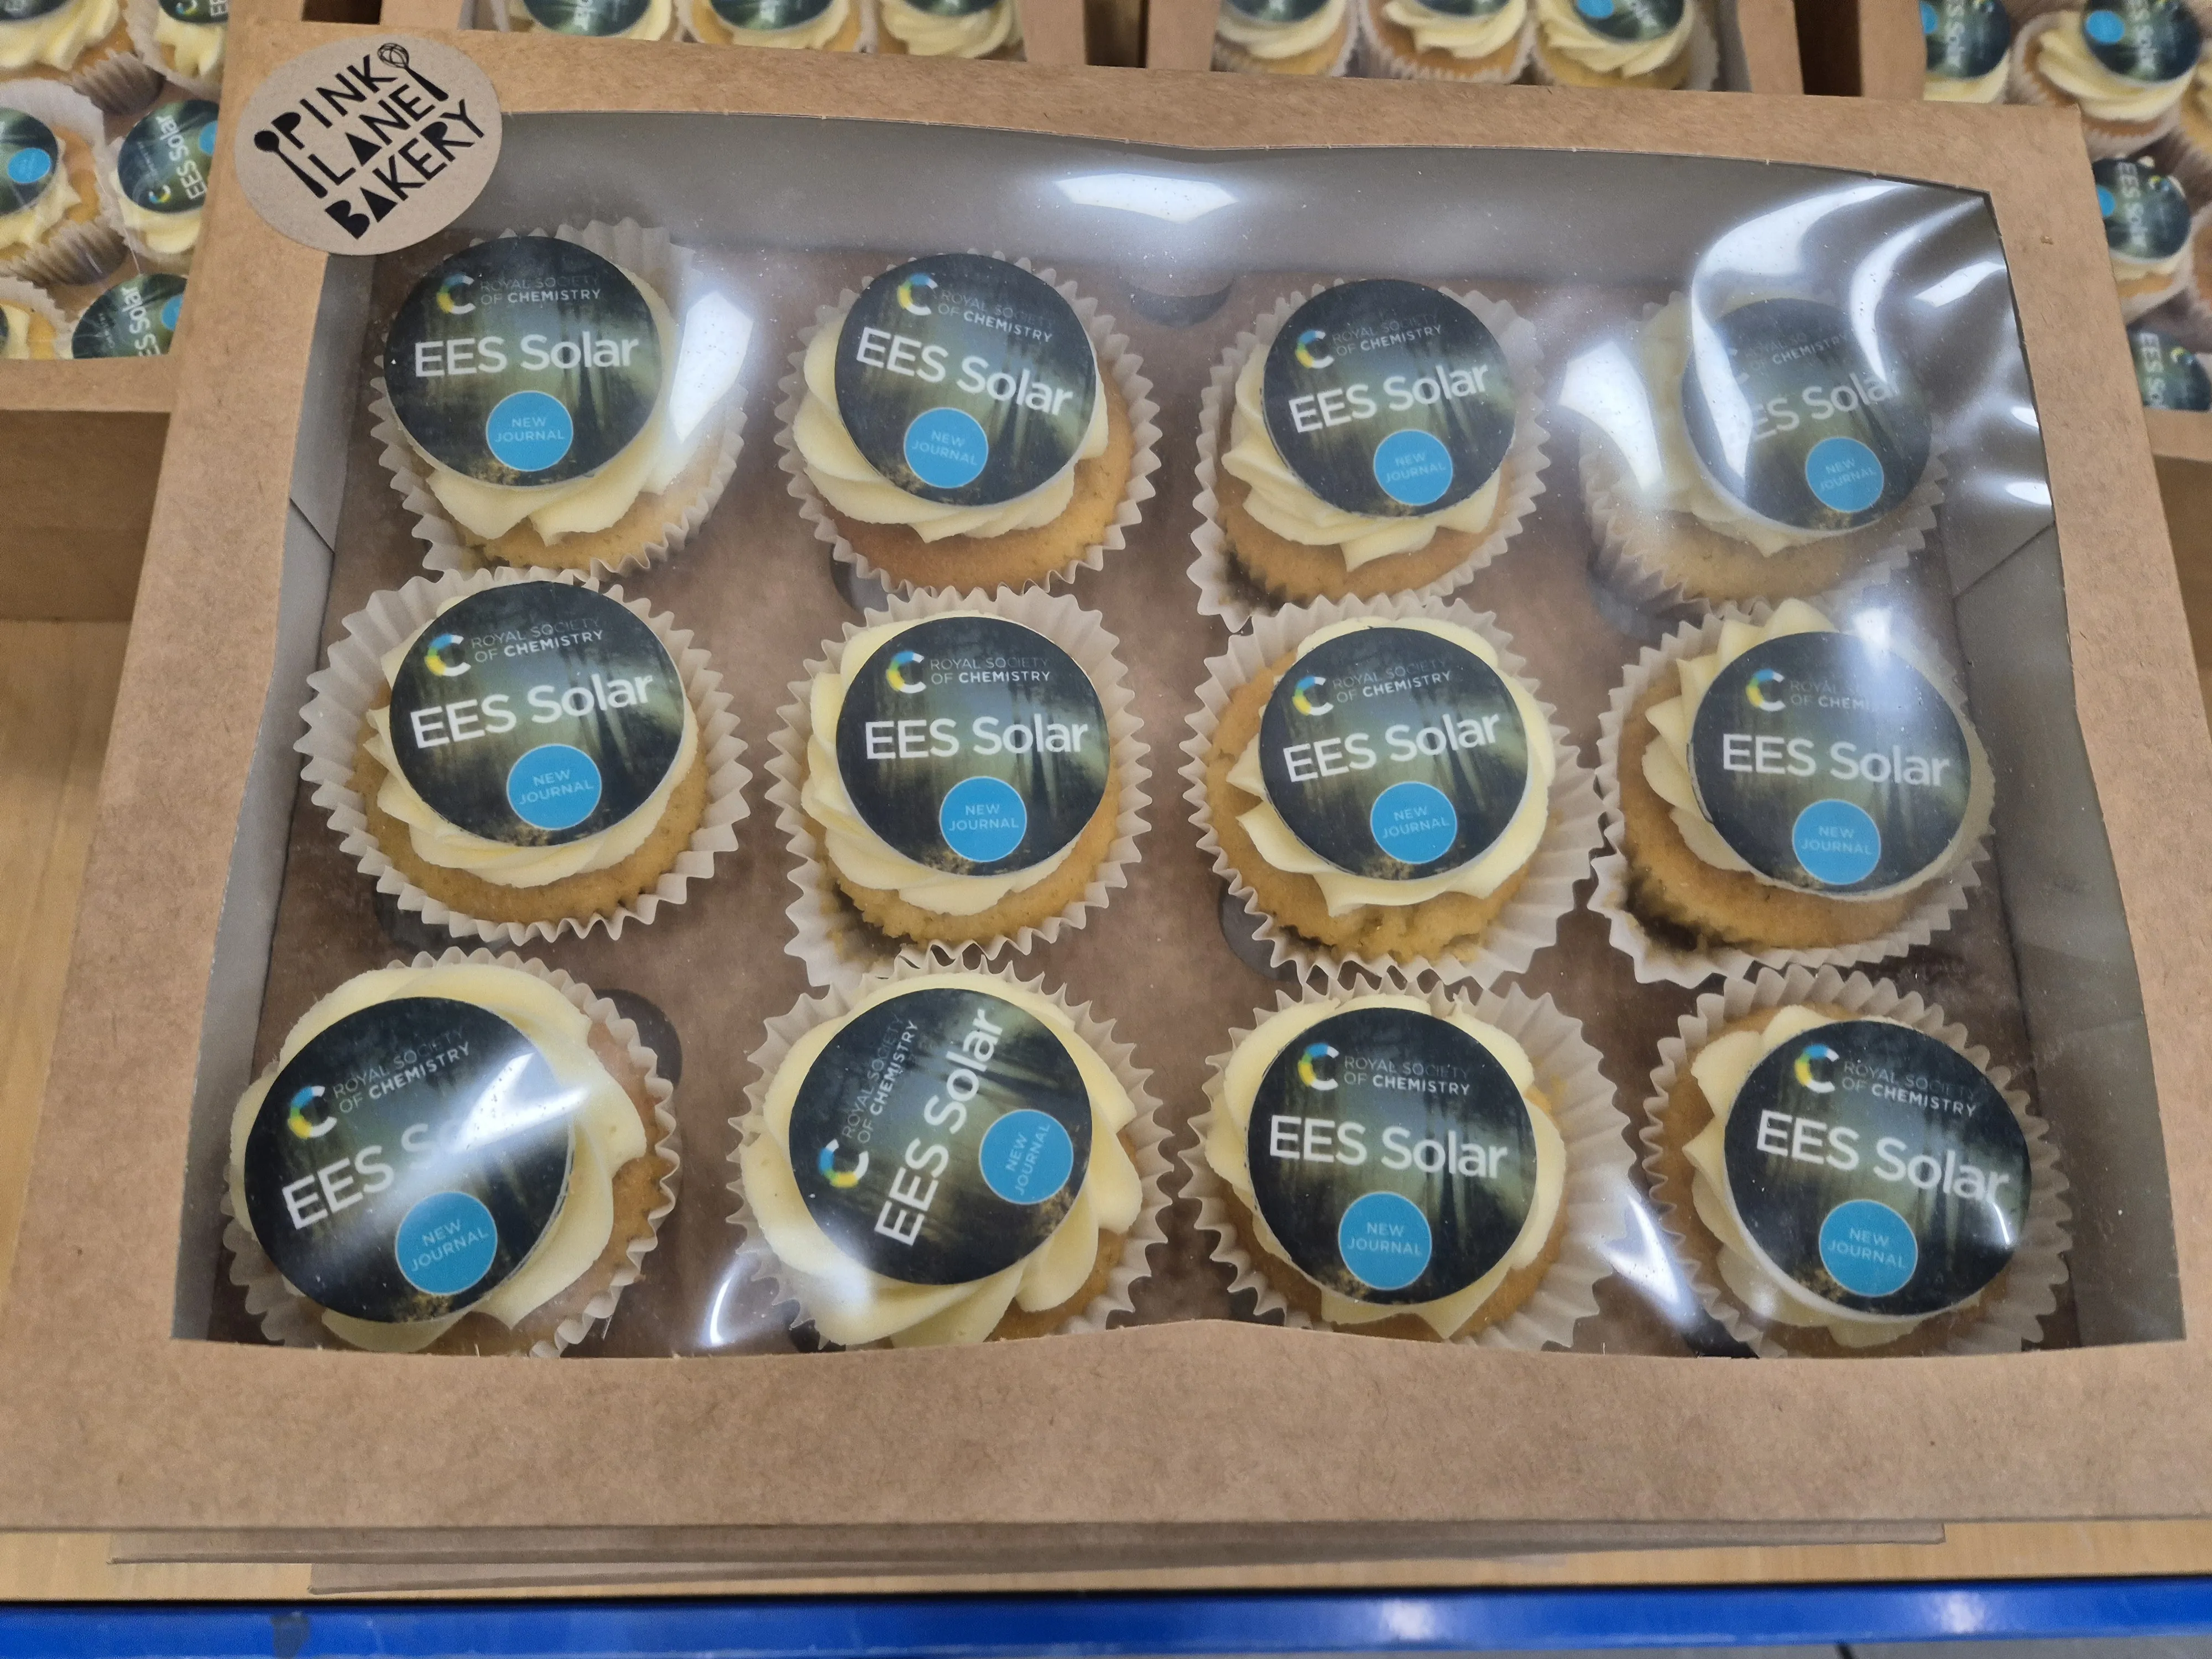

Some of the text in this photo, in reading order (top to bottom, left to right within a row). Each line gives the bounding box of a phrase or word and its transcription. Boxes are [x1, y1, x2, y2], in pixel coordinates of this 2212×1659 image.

[271, 54, 398, 150] PINK
[156, 116, 189, 161] Solar
[308, 84, 436, 186] LANE
[325, 99, 484, 239] BAKERY
[481, 279, 530, 293] ROYAL
[481, 289, 601, 305] OF CHEMISTRY
[941, 289, 988, 312] ROYAL
[938, 304, 1052, 342] OF CHEMISTRY
[1332, 326, 1375, 343] ROYAL
[1336, 325, 1442, 357] OF CHEMISTRY
[415, 331, 639, 378] EES Solar
[857, 327, 1073, 416] EES Solar
[1288, 364, 1488, 433] EES Solar
[512, 417, 547, 428] NEW
[495, 430, 565, 441] JOURNAL
[931, 430, 966, 447] NEW
[911, 442, 977, 466] JOURNAL
[1395, 452, 1427, 467] NEW
[1826, 458, 1856, 474] NEW
[1386, 463, 1446, 483] JOURNAL
[1819, 467, 1876, 491] JOURNAL
[472, 631, 526, 648] ROYAL
[474, 630, 604, 663] OF CHEMISTRY
[931, 657, 1050, 670] ROYAL SOCIETY
[931, 671, 1051, 685] OF CHEMISTRY
[1333, 672, 1380, 689] ROYAL
[1336, 671, 1451, 703] OF CHEMISTRY
[410, 674, 653, 748] EES Solar
[1791, 693, 1809, 706] OF
[865, 713, 1088, 759] EES Solar
[1283, 713, 1500, 782] EES Solar
[1723, 733, 1952, 787] EES Solar
[533, 769, 572, 786] NEW
[518, 780, 594, 806] JOURNAL
[966, 804, 1000, 816] NEW
[1394, 806, 1429, 821] NEW
[949, 818, 1019, 831] JOURNAL
[1382, 816, 1450, 839] JOURNAL
[1819, 826, 1855, 839] NEW
[1801, 839, 1872, 855] JOURNAL
[1345, 1055, 1396, 1073] ROYAL
[1844, 1062, 1899, 1084] ROYAL
[333, 1067, 390, 1099] ROYAL
[340, 1042, 471, 1113] OF CHEMISTRY
[857, 1020, 919, 1144] OF CHEMISTRY
[1344, 1074, 1471, 1095] OF CHEMISTRY
[1842, 1077, 1978, 1118] OF CHEMISTRY
[842, 1093, 868, 1139] ROYAL
[874, 1008, 1003, 1247] EES Solar
[1005, 1131, 1026, 1171] NEW
[1270, 1114, 1507, 1179] EES Solar
[1757, 1109, 2010, 1203] EES Solar
[1014, 1124, 1051, 1196] JOURNAL
[282, 1145, 394, 1230] EES
[422, 1218, 462, 1246] NEW
[1366, 1222, 1405, 1238] NEW
[1849, 1227, 1891, 1248] NEW
[411, 1228, 489, 1272] JOURNAL
[1348, 1237, 1422, 1256] JOURNAL
[1827, 1240, 1906, 1270] JOURNAL
